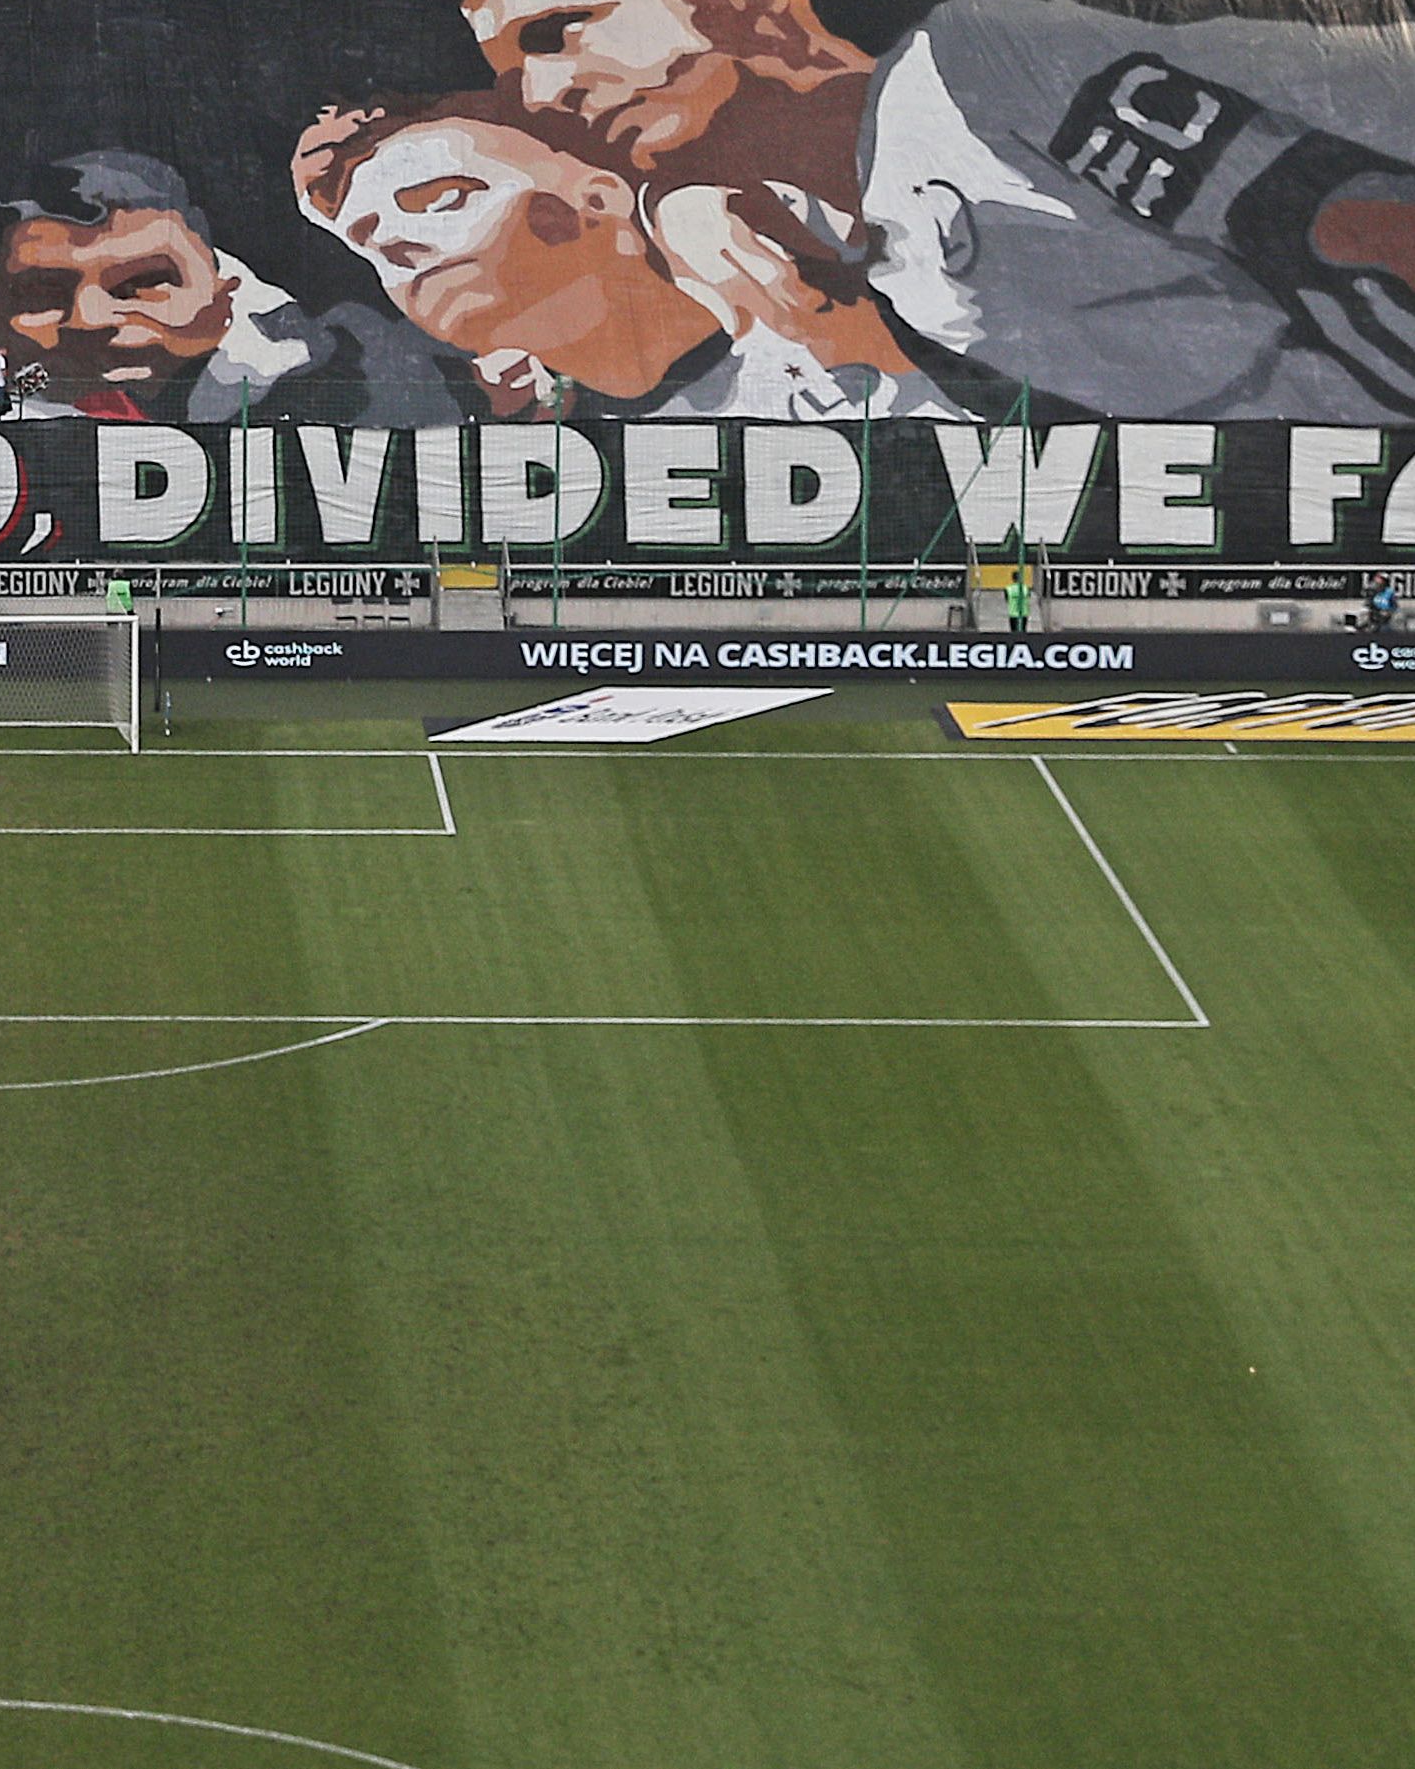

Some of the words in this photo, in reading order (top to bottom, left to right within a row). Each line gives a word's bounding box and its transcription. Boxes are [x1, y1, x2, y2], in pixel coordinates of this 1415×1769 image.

[97, 423, 861, 545] DIVIDED
[934, 423, 1217, 546] WE
[196, 575, 218, 589] dla
[289, 571, 386, 596] LEGIONY
[670, 572, 769, 597] LEGIONY
[1054, 571, 1153, 597] LEGIONY
[264, 642, 344, 655] cashback
[264, 655, 312, 667] world
[520, 642, 645, 673] WIĘCEJ
[655, 643, 710, 668] NA
[717, 643, 1135, 669] CASHBACK.LEGIA.COM
